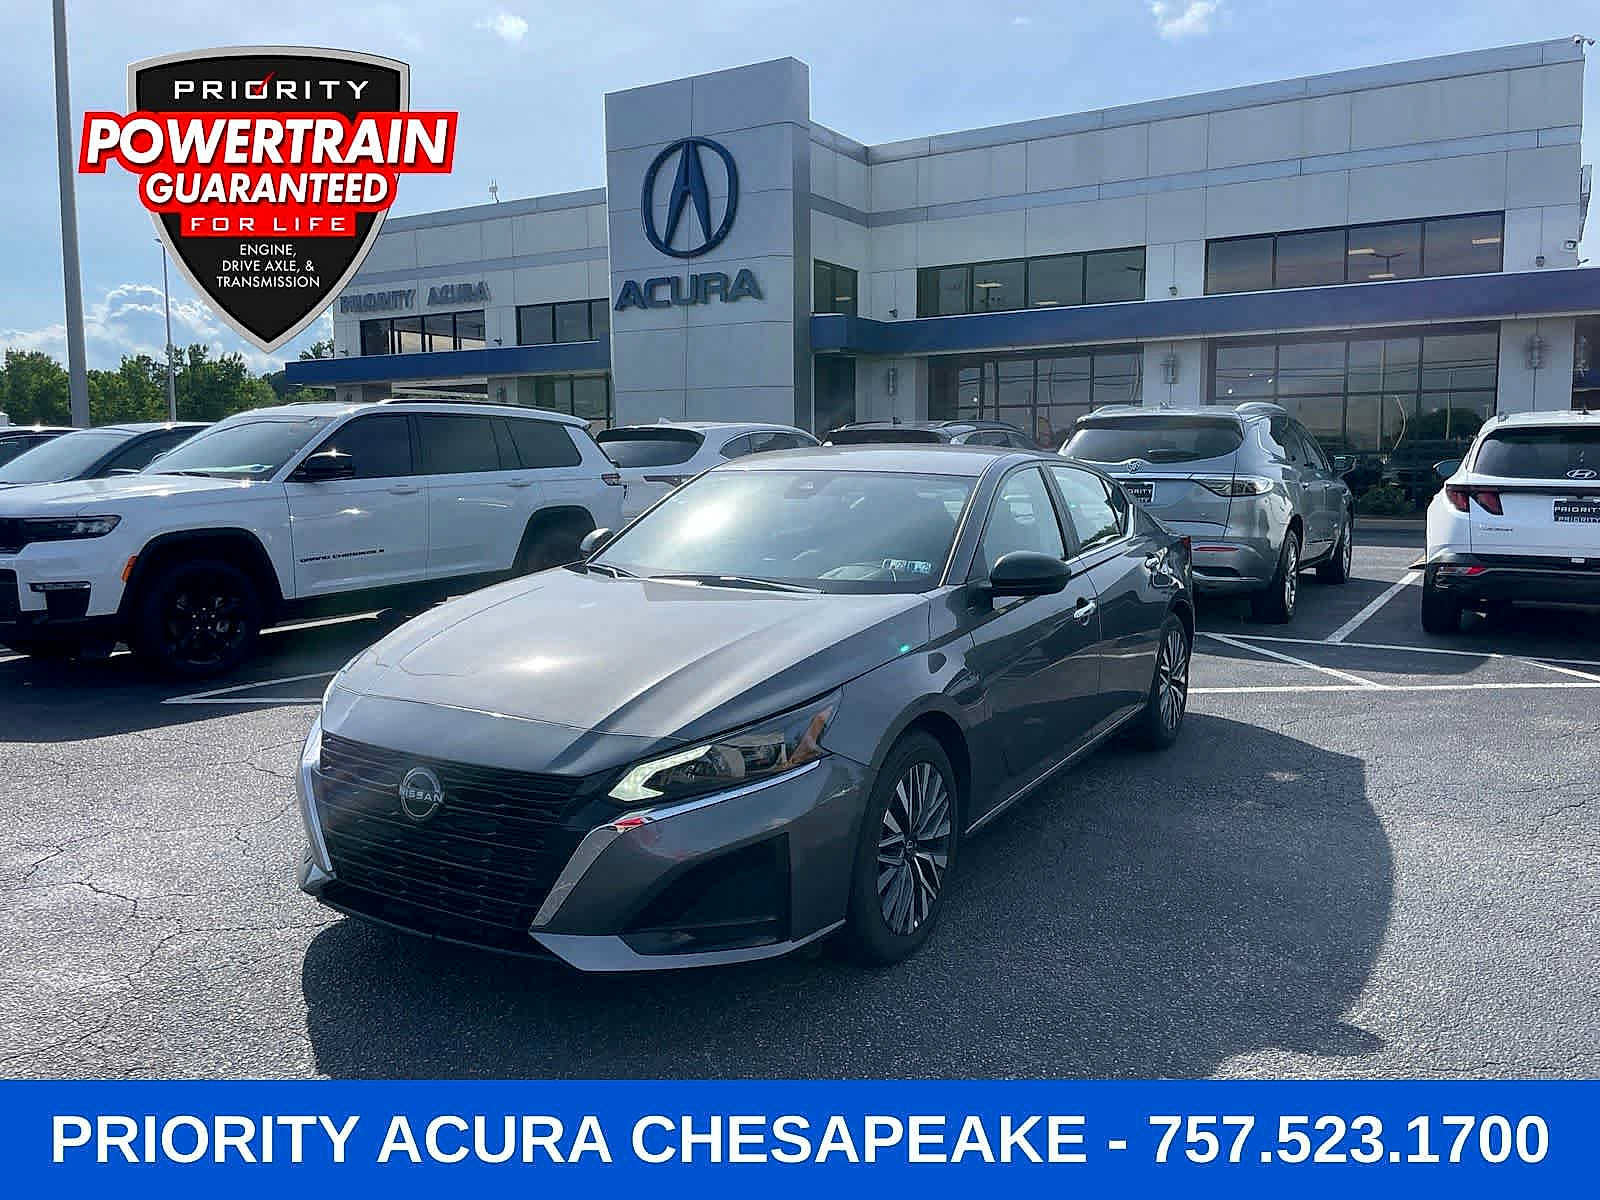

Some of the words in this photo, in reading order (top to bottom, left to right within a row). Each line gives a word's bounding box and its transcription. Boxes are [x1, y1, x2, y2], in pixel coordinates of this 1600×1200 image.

[339, 289, 416, 313] PRIORITY
[427, 281, 491, 306] ACURA
[614, 268, 765, 311] ACURA
[400, 786, 443, 802] NISSAN
